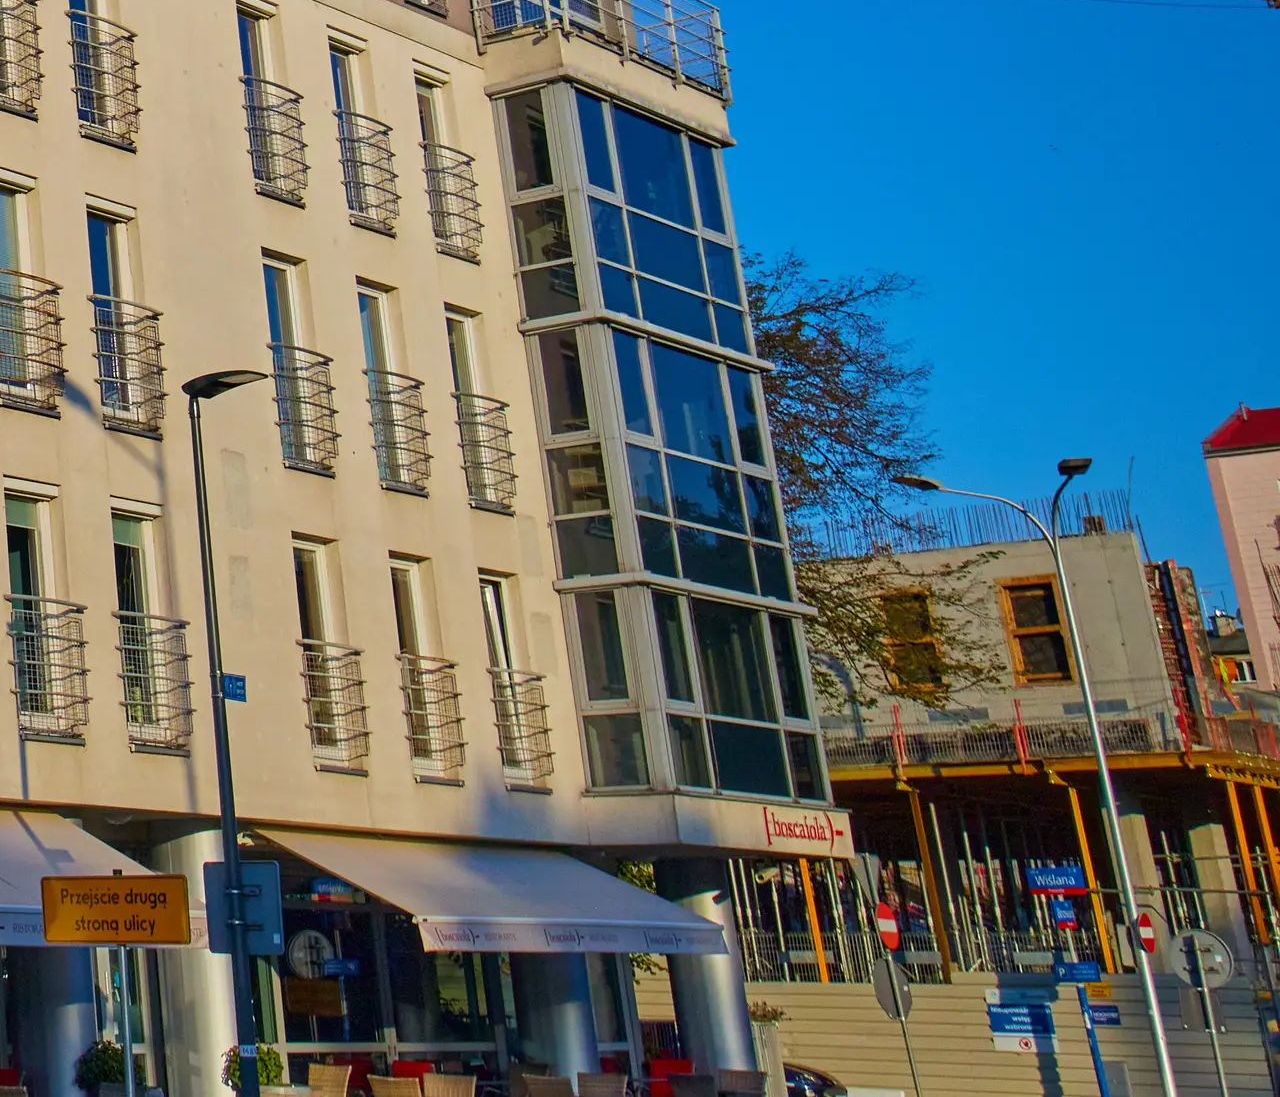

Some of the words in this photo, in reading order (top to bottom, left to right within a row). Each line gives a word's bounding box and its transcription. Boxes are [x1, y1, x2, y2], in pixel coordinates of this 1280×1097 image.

[1034, 873, 1076, 887] Wiślana
[60, 887, 120, 908] Przejście
[124, 888, 167, 909] drugą
[75, 916, 120, 936] stroną
[124, 915, 156, 936] ulicy
